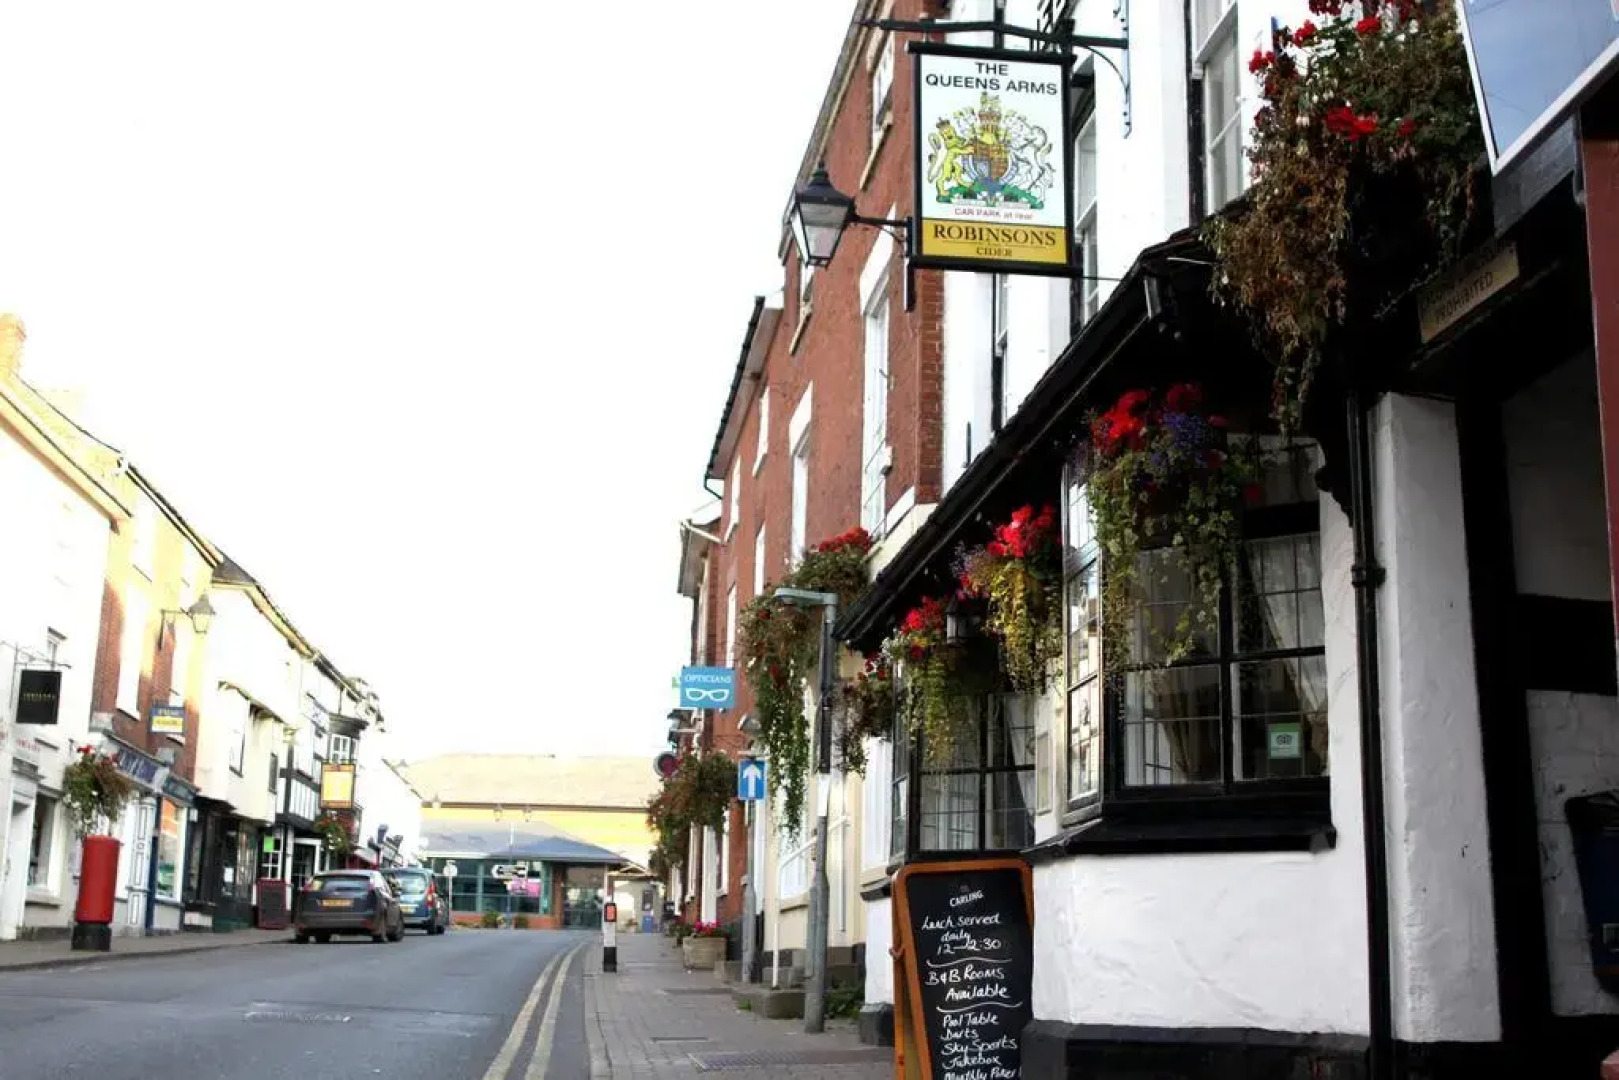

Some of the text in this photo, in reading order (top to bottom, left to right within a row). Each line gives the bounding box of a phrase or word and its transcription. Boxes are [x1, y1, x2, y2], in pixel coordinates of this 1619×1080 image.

[975, 62, 1009, 76] THE
[926, 74, 1058, 96] QUEENS ARMS
[954, 208, 974, 216] CAR
[976, 209, 1000, 217] PARK
[933, 224, 1056, 246] ROBINSONS
[976, 246, 1012, 257] CIDER
[684, 674, 731, 684] OPTICIANS
[949, 890, 984, 907] CARLING
[921, 912, 1001, 931] Lunch served
[940, 928, 971, 948] daily
[945, 983, 1010, 1001] Available
[943, 1012, 999, 1028] Pool Table
[941, 1027, 979, 1041] Darts
[941, 1034, 1018, 1057] Sky Sports
